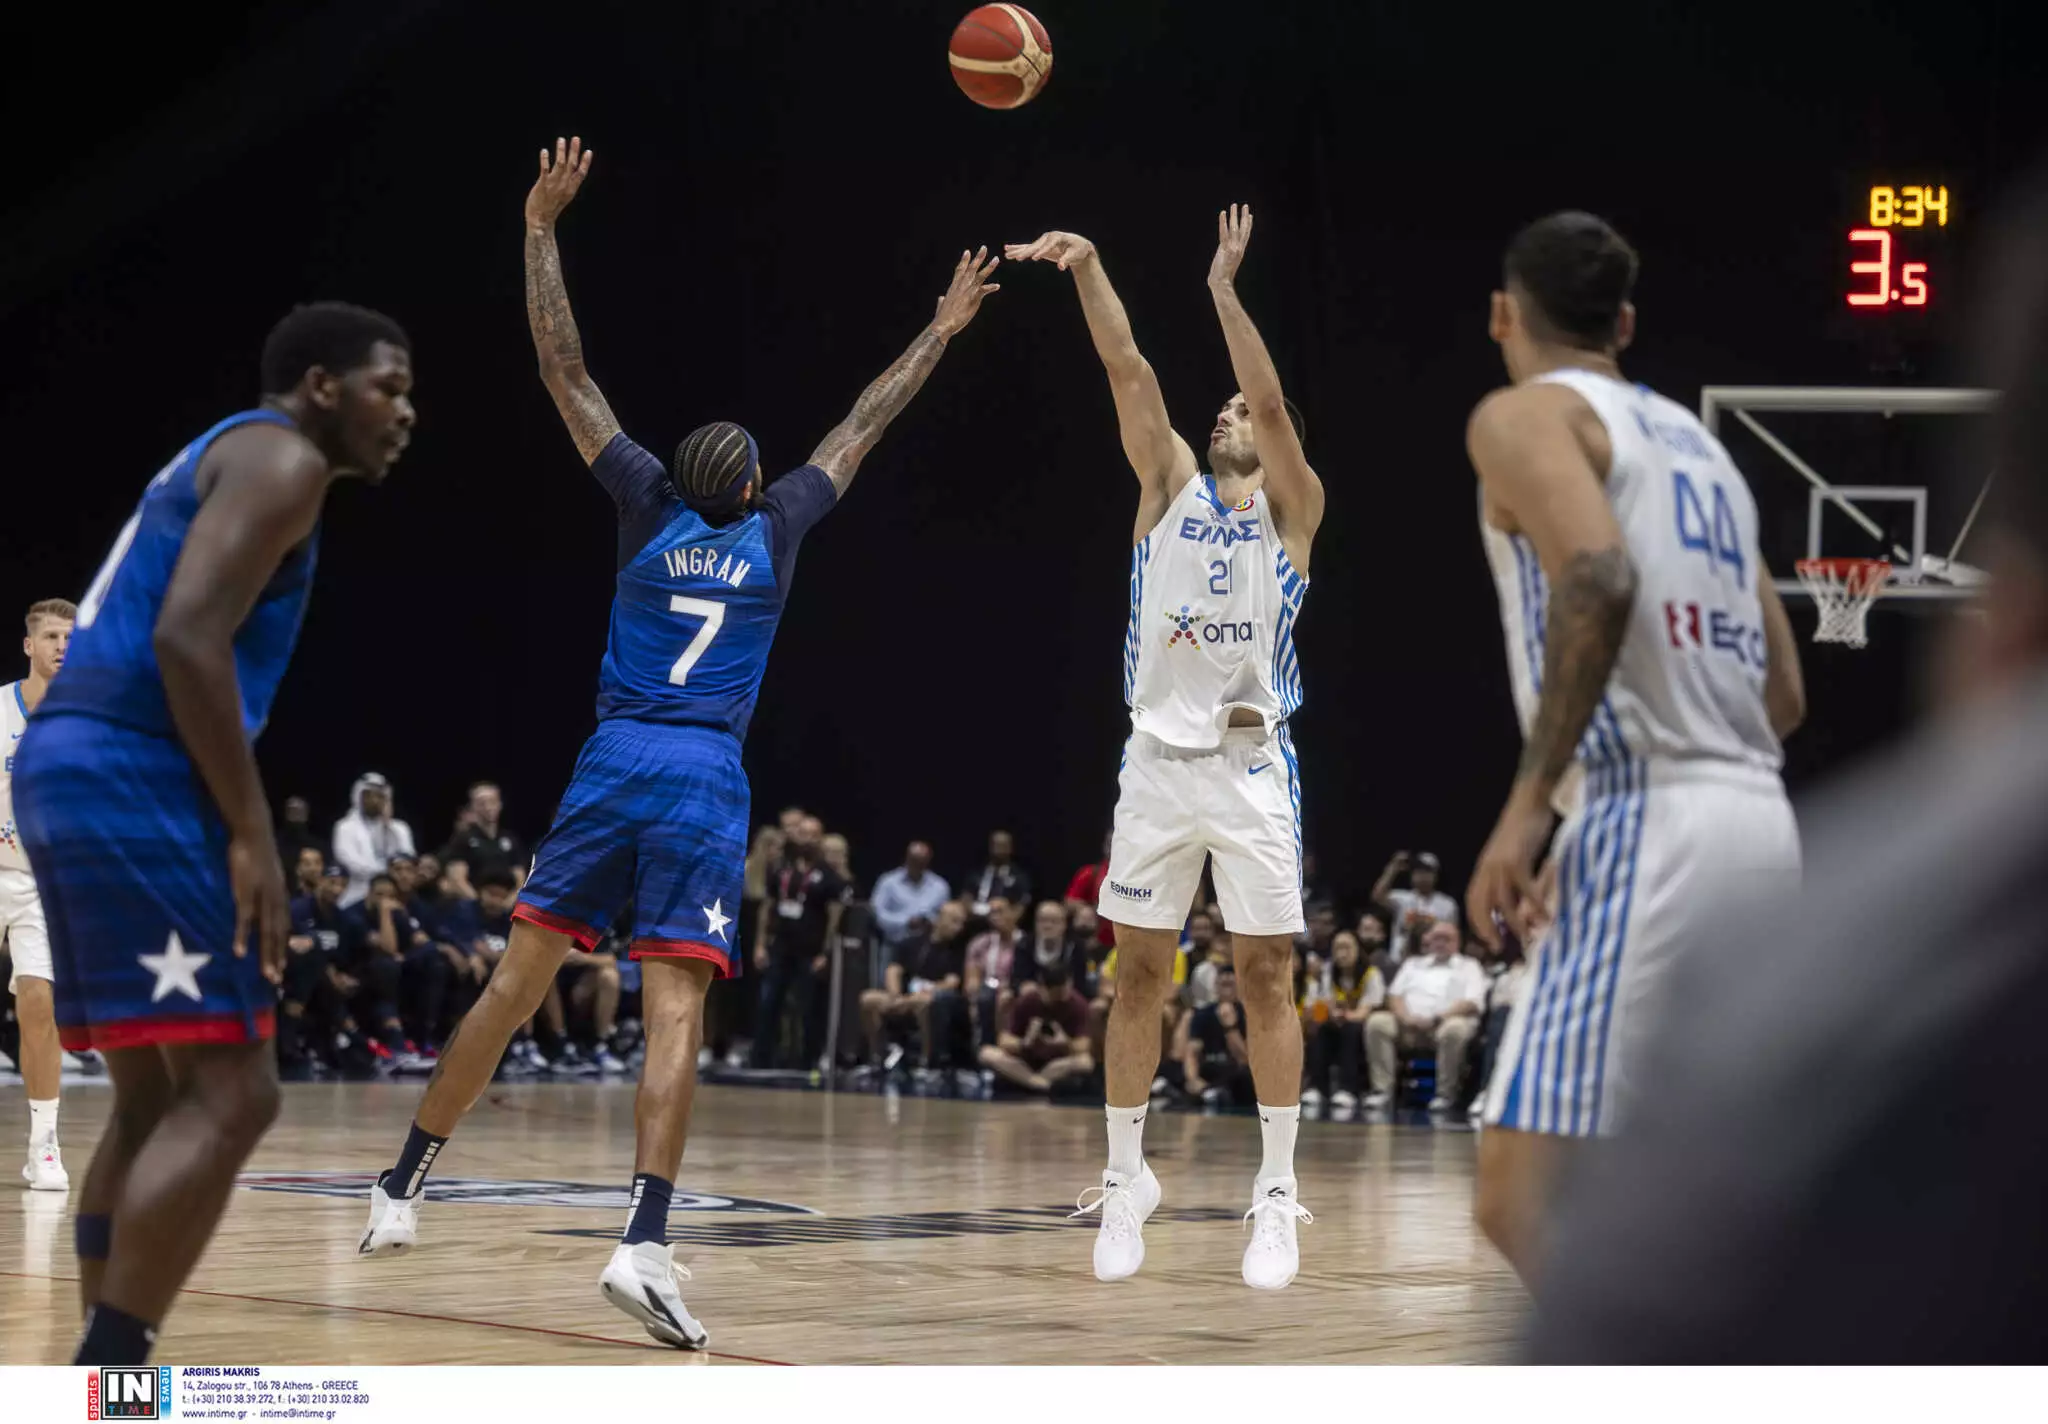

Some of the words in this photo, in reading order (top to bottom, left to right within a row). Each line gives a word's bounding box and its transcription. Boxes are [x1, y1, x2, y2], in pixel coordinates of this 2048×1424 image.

[1870, 186, 1948, 226] 8:34
[1847, 230, 1928, 305] 3.5
[1672, 470, 1746, 592] 44
[668, 594, 726, 687] 7
